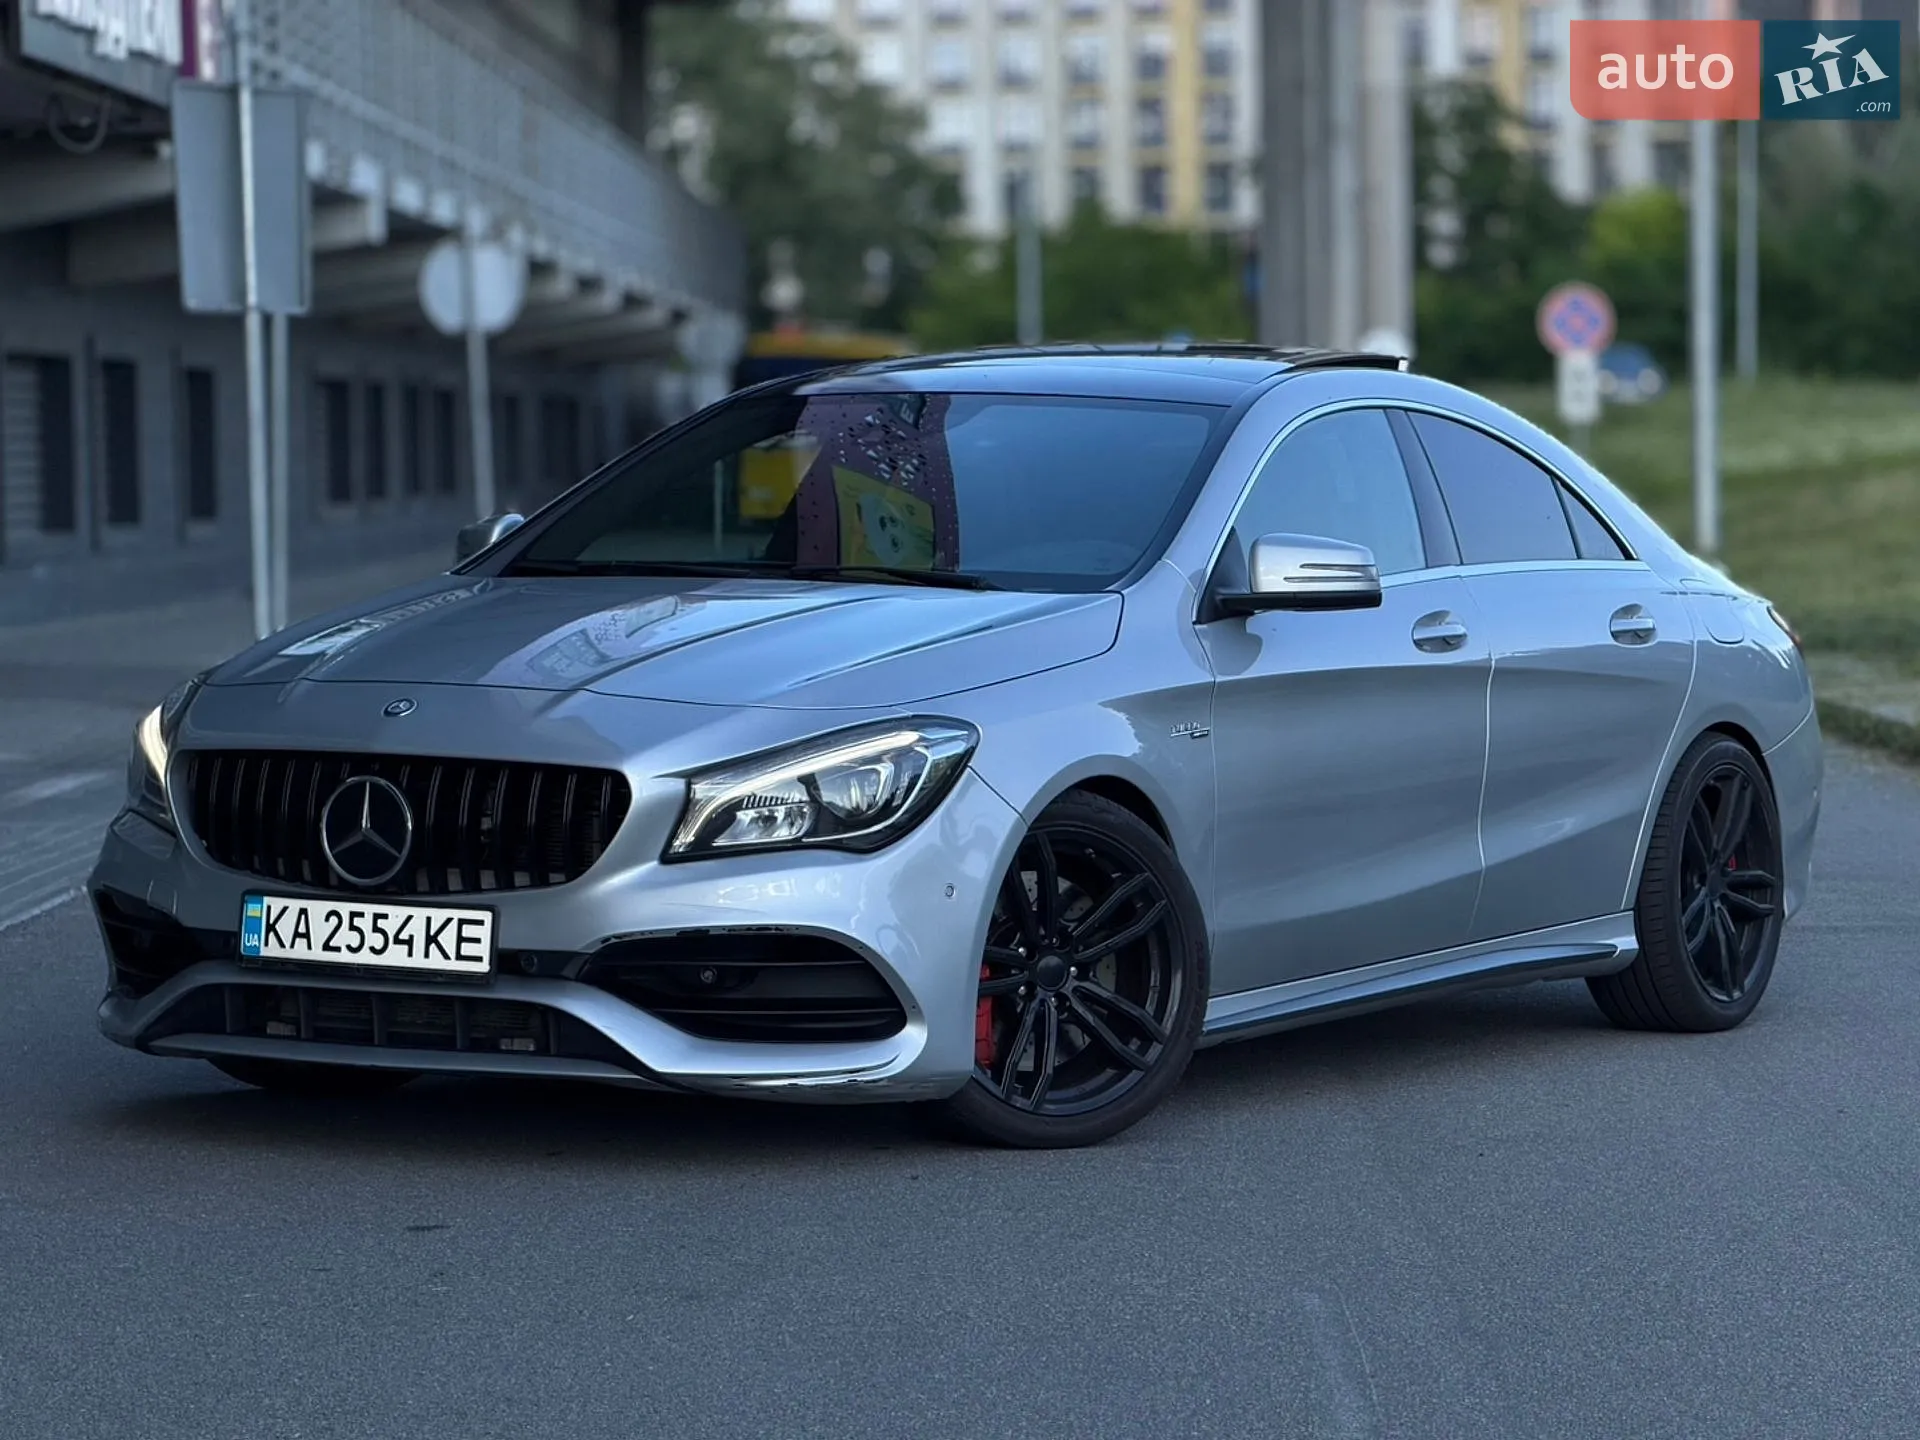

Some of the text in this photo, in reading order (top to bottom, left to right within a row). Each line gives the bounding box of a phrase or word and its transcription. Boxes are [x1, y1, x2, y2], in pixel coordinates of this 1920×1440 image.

[245, 933, 259, 947] UA
[264, 905, 485, 962] KA 2554 KE
